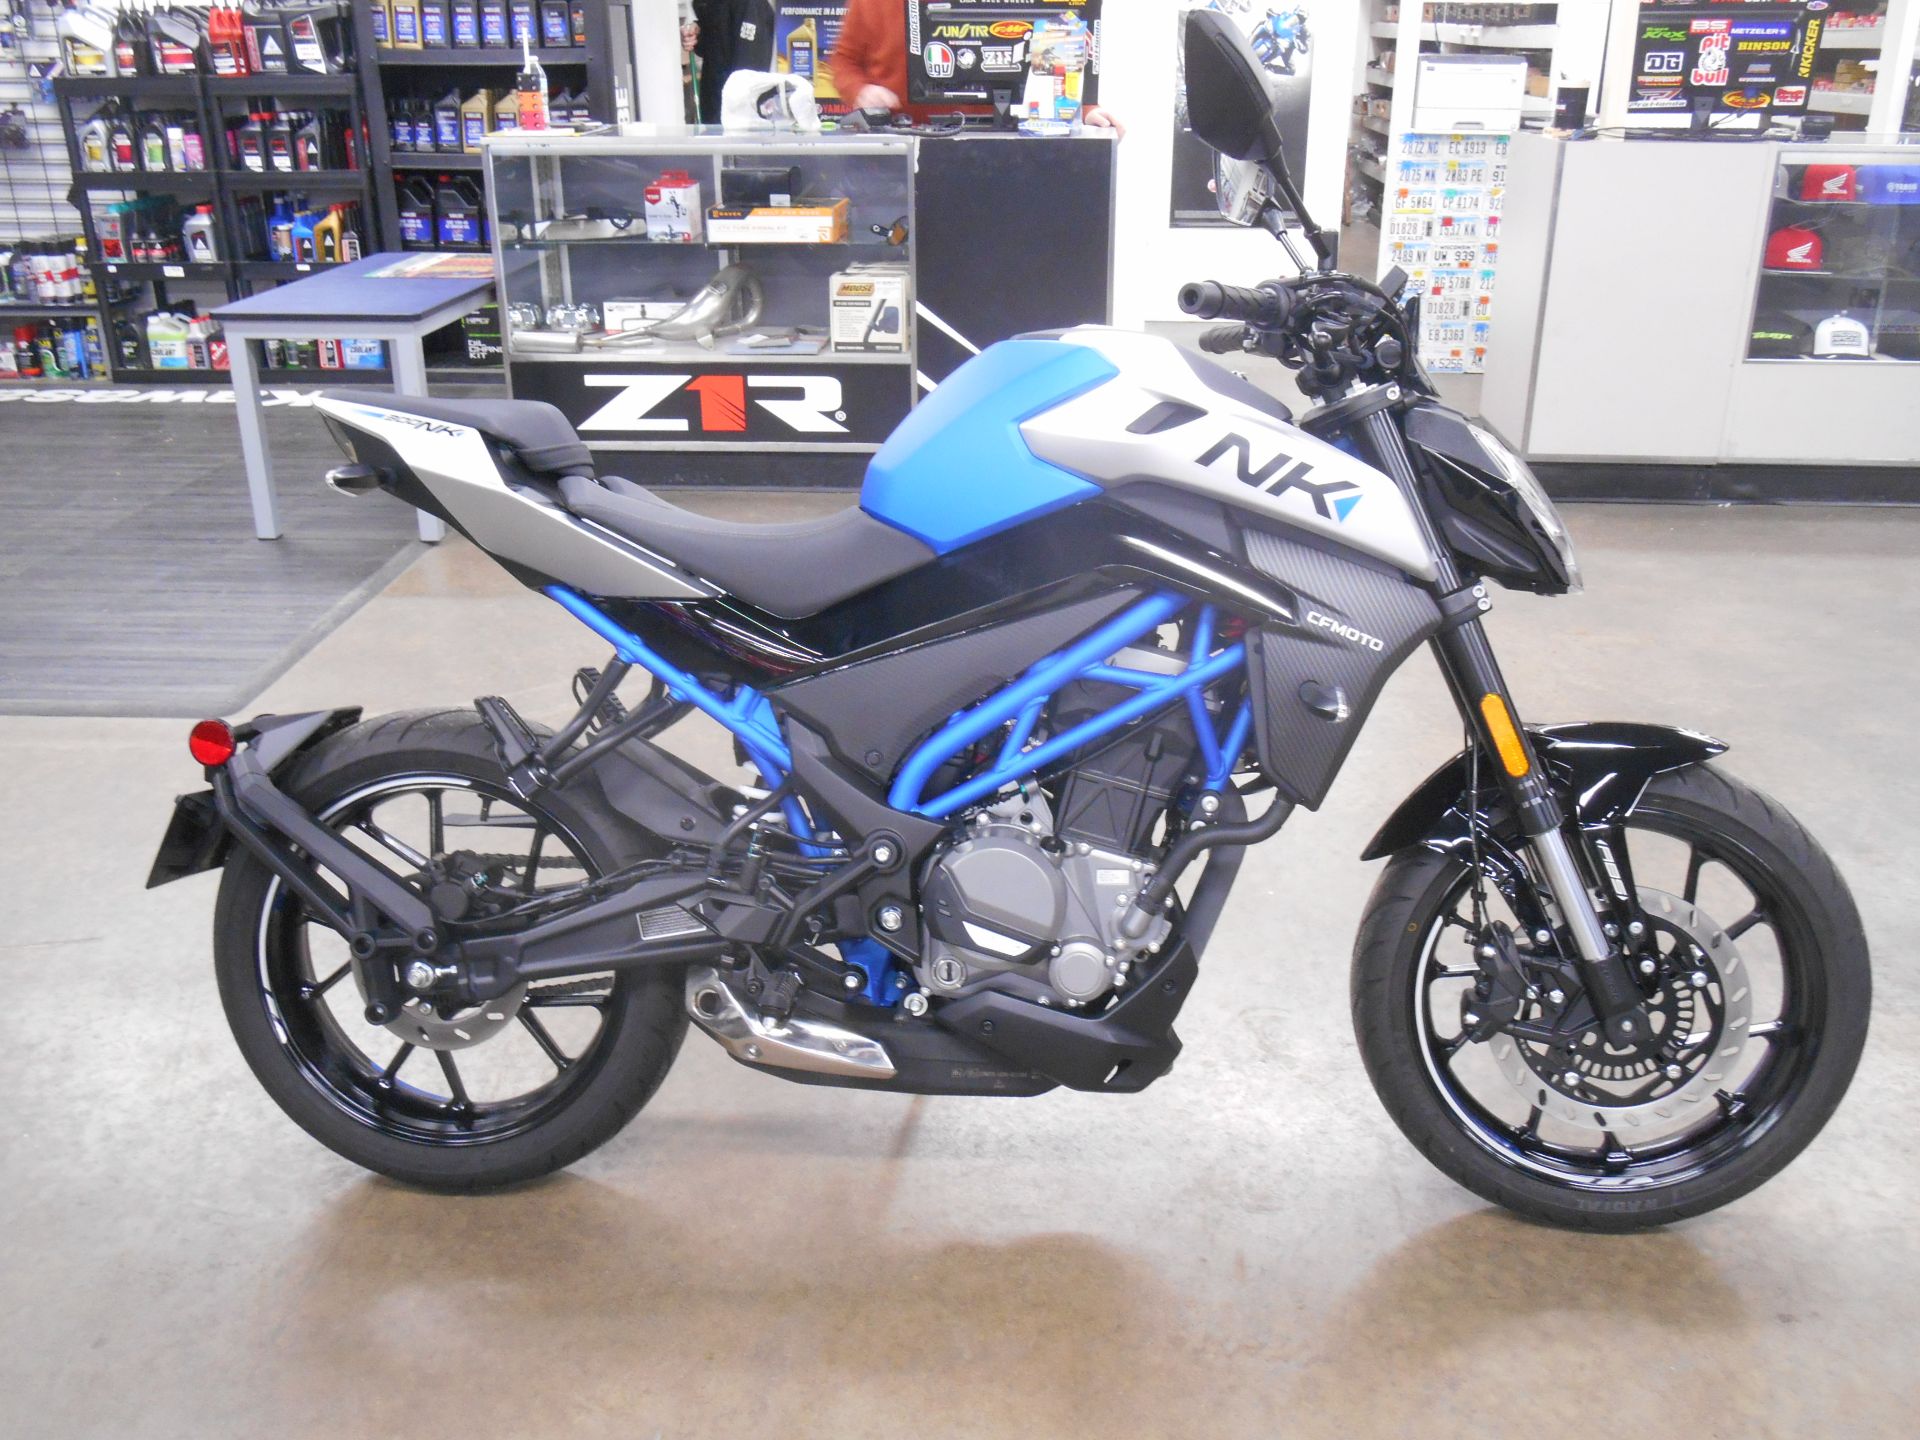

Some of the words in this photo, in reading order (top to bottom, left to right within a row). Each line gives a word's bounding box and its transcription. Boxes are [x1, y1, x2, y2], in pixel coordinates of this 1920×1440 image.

[931, 23, 990, 38] SUNSTAR
[1690, 20, 1728, 30] BS
[1731, 27, 1779, 35] METZELER
[1702, 34, 1730, 52] pit
[1737, 41, 1791, 51] HINSON
[1800, 19, 1821, 70] KICKER
[1646, 53, 1682, 71] DG
[1692, 69, 1728, 84] bull
[1455, 251, 1475, 261] 939
[469, 352, 487, 360] KIT
[1194, 431, 1362, 520] NK
[1306, 611, 1385, 652] CFMOTO
